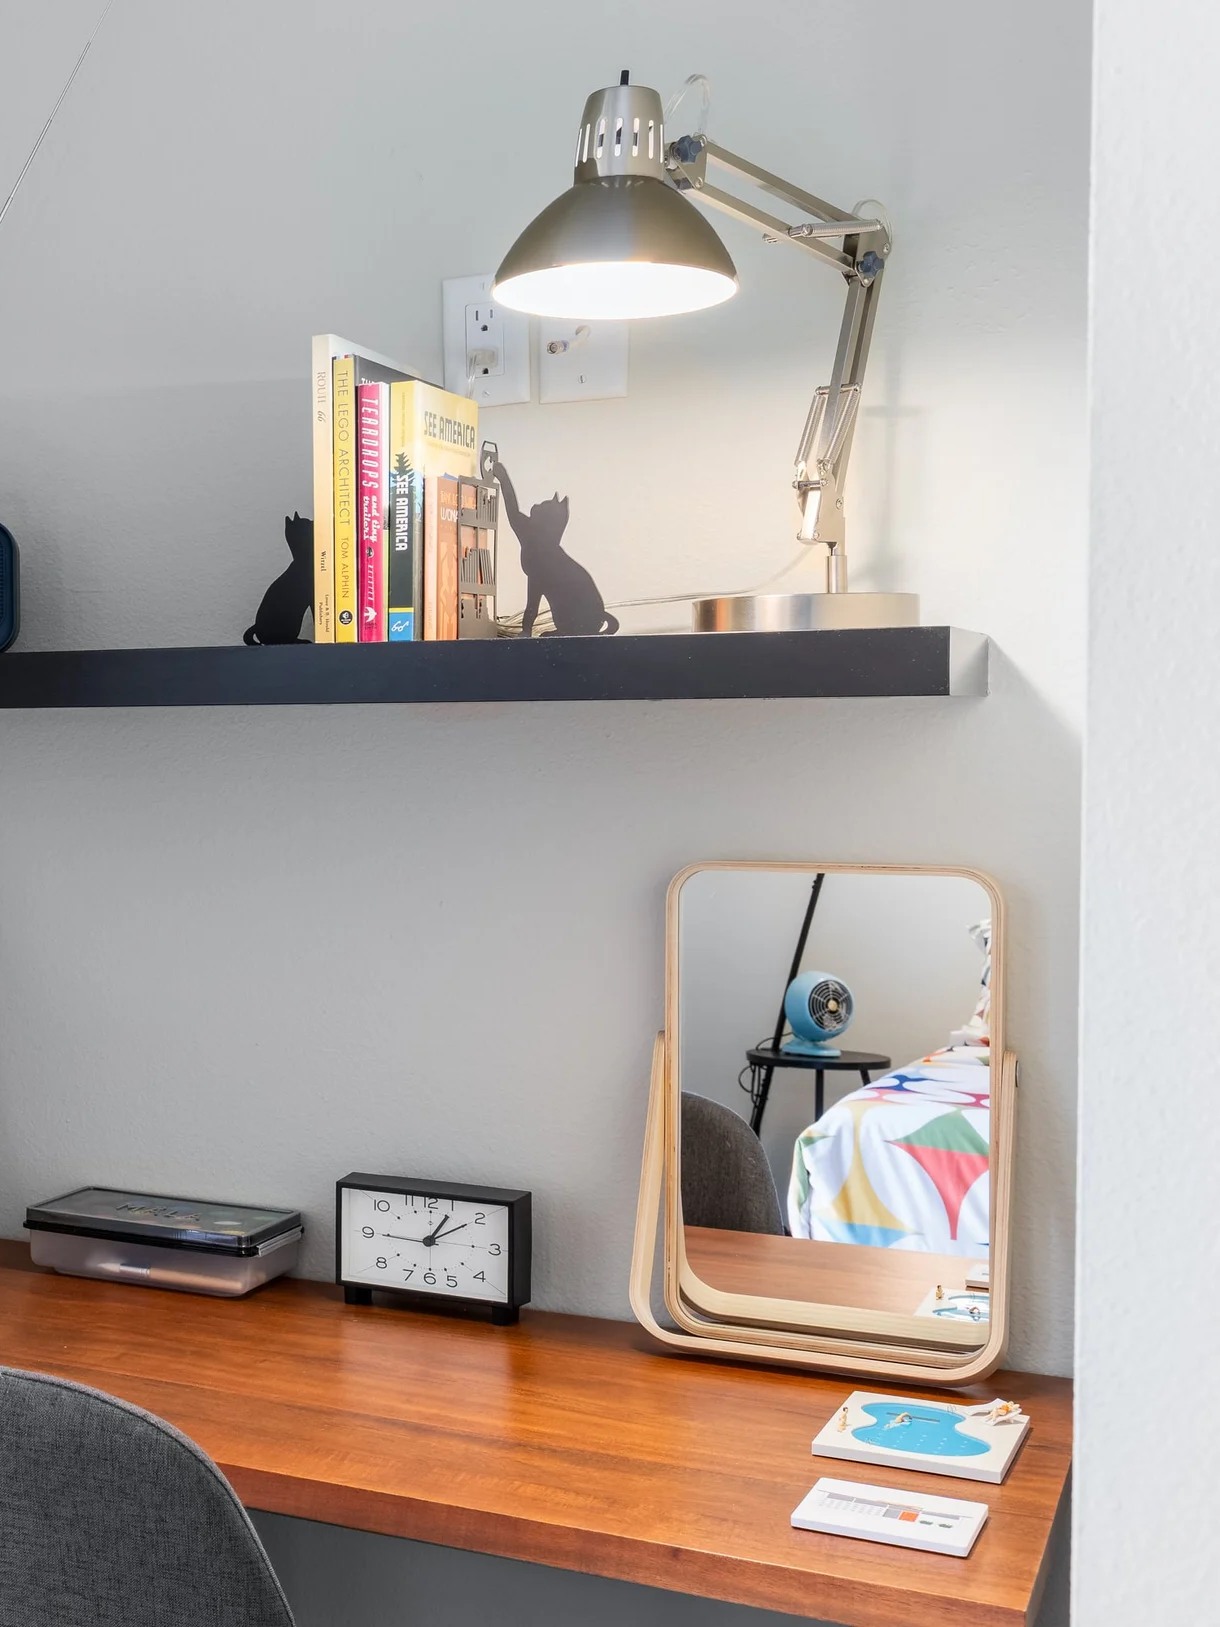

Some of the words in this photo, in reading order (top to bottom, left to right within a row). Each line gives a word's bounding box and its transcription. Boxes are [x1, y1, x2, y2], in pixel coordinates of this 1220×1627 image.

[337, 370, 349, 396] THE
[338, 403, 349, 441] LEGO
[423, 411, 437, 438] SEE
[439, 416, 475, 450] AMERICA
[361, 398, 379, 489] TEARDROPS
[338, 448, 351, 525] ARCHITECT
[396, 475, 409, 494] SEE
[372, 495, 380, 516] and
[363, 496, 371, 540] trailers
[395, 497, 409, 551] AMERICA
[370, 519, 380, 543] tiny
[340, 537, 349, 559] TOM
[341, 563, 349, 598] ALPHIN
[373, 1199, 391, 1213] 10
[423, 1196, 439, 1210] 12
[474, 1212, 486, 1225] 2
[361, 1226, 375, 1239] 9
[488, 1243, 502, 1256] 3
[375, 1256, 388, 1269] 8
[402, 1268, 414, 1281] 7
[423, 1272, 437, 1285] 6
[446, 1275, 458, 1288] 5
[473, 1270, 486, 1283] 4
